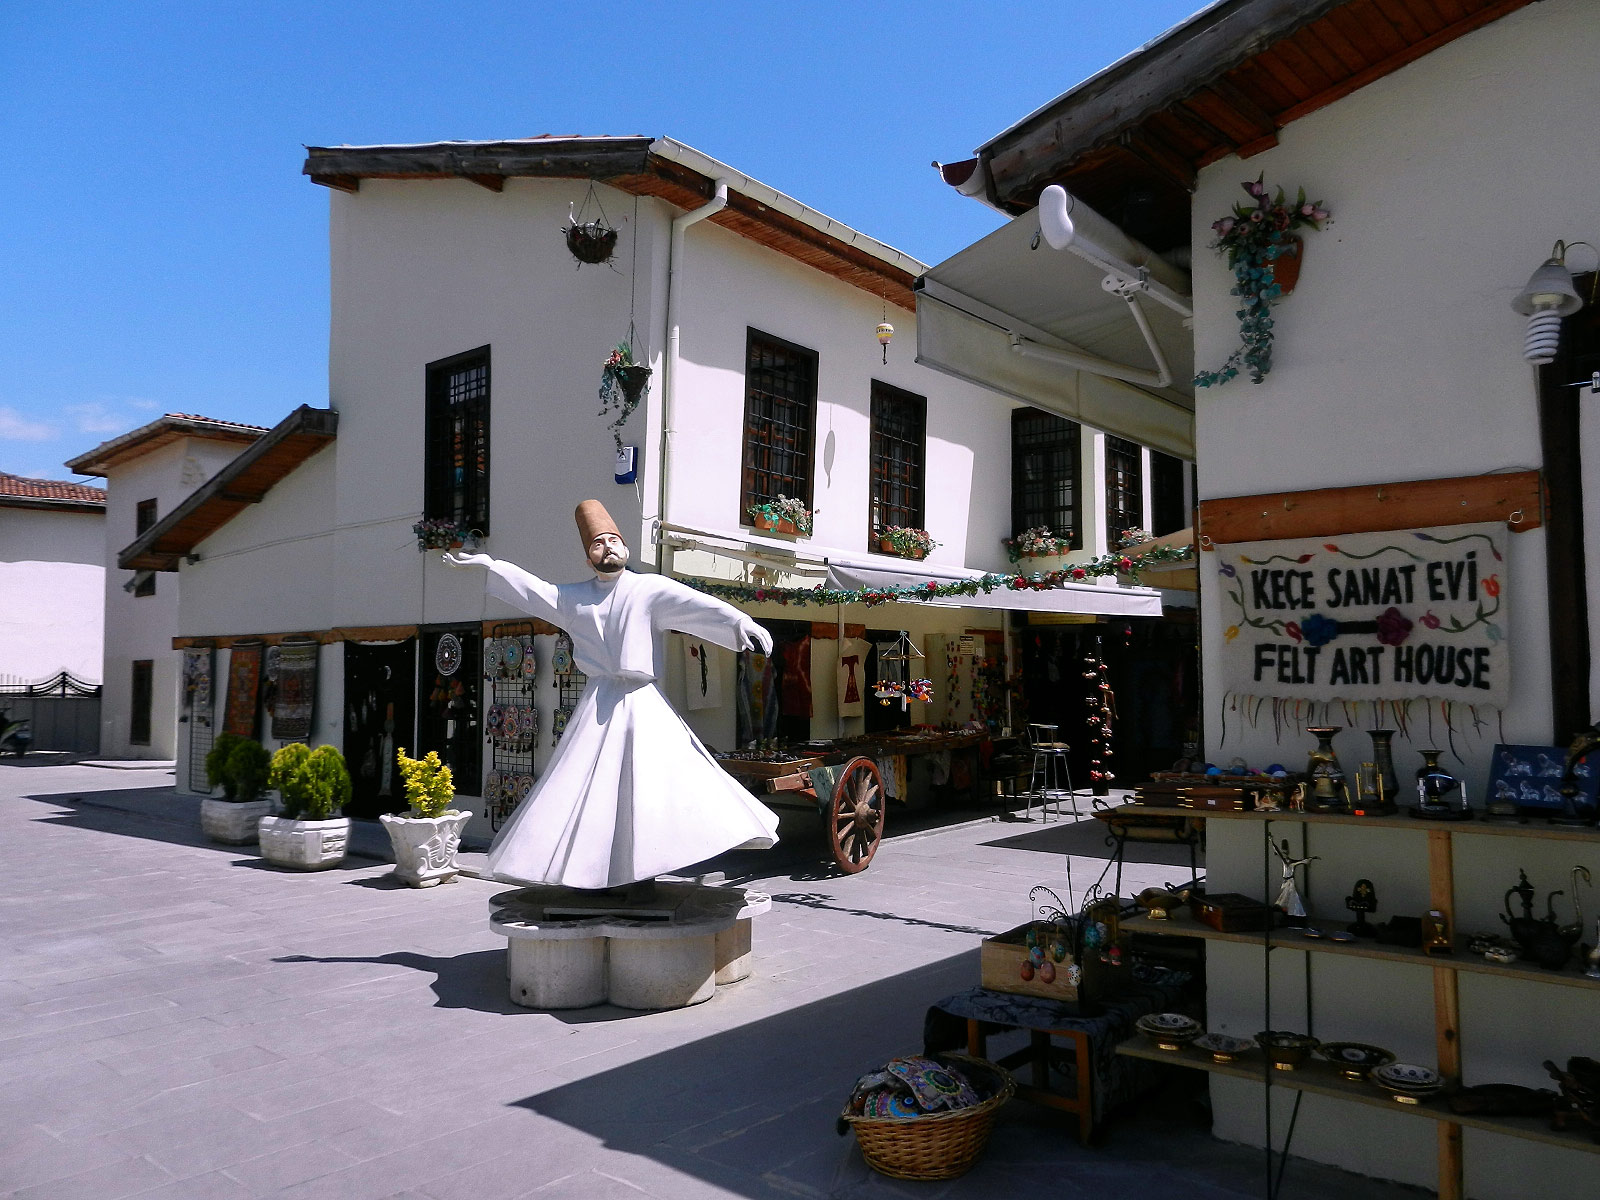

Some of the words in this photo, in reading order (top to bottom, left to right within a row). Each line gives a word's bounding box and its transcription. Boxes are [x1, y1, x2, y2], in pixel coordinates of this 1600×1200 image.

[1252, 569, 1316, 610] KEÇE
[1326, 564, 1417, 608] SANAT
[1427, 550, 1478, 603] EVİ
[1254, 643, 1322, 685] FELT
[1329, 645, 1386, 686] ART
[1393, 643, 1491, 690] HOUSE
